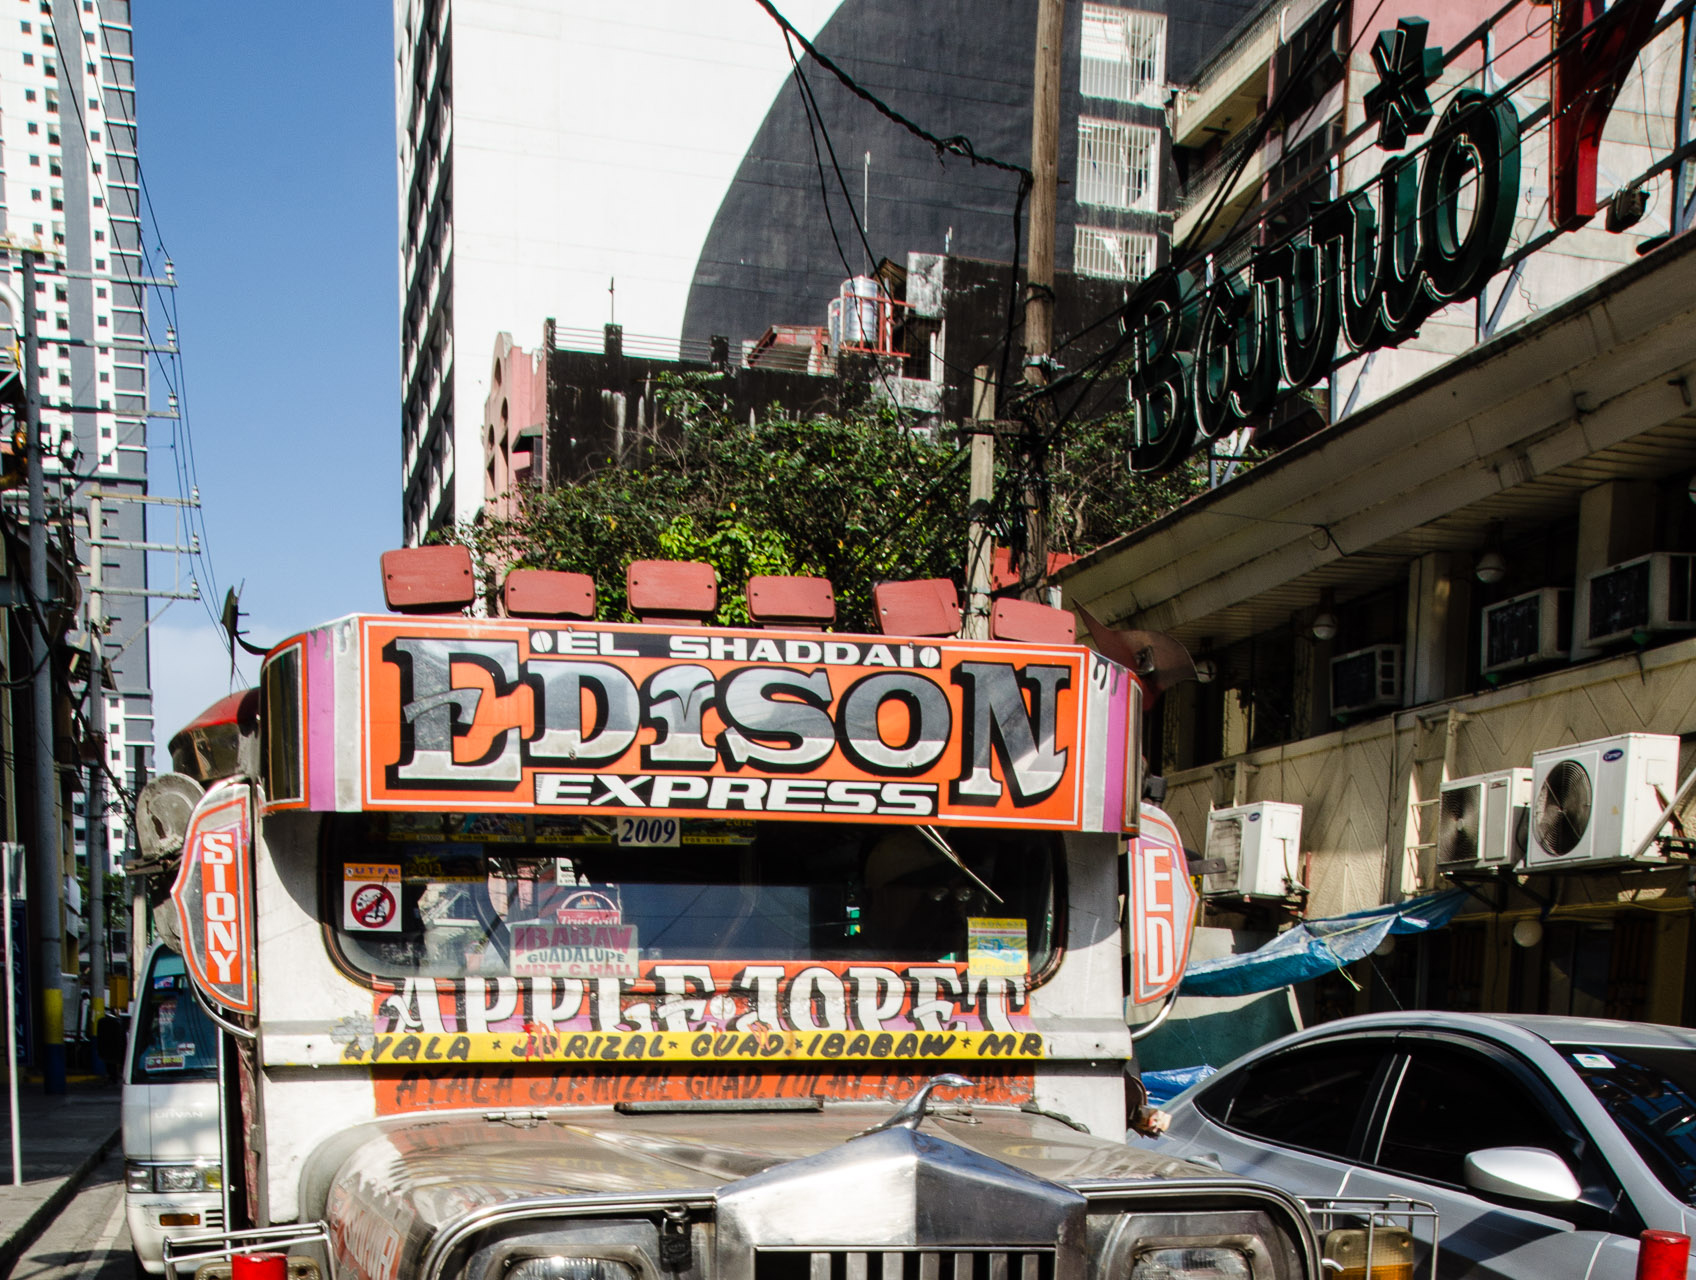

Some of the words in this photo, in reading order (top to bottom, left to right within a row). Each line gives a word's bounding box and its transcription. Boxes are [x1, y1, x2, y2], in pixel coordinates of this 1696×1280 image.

[556, 630, 639, 660] EL
[669, 637, 915, 668] SHADDAI
[546, 776, 936, 816] EXPRESS
[620, 818, 677, 844] 2009
[203, 833, 237, 982] SIONY
[1144, 848, 1172, 984] ED
[514, 927, 633, 957] IBABAW
[527, 947, 625, 963] GUADALUPE
[515, 964, 562, 976] MRT
[380, 966, 716, 1033] APPLE
[344, 1035, 471, 1061] AYALA
[564, 1034, 665, 1060] RIZAL
[692, 1034, 792, 1058] GUAD.
[806, 1034, 956, 1058] IBABAW
[978, 1033, 1043, 1057] MR
[396, 1067, 515, 1105] AYALA
